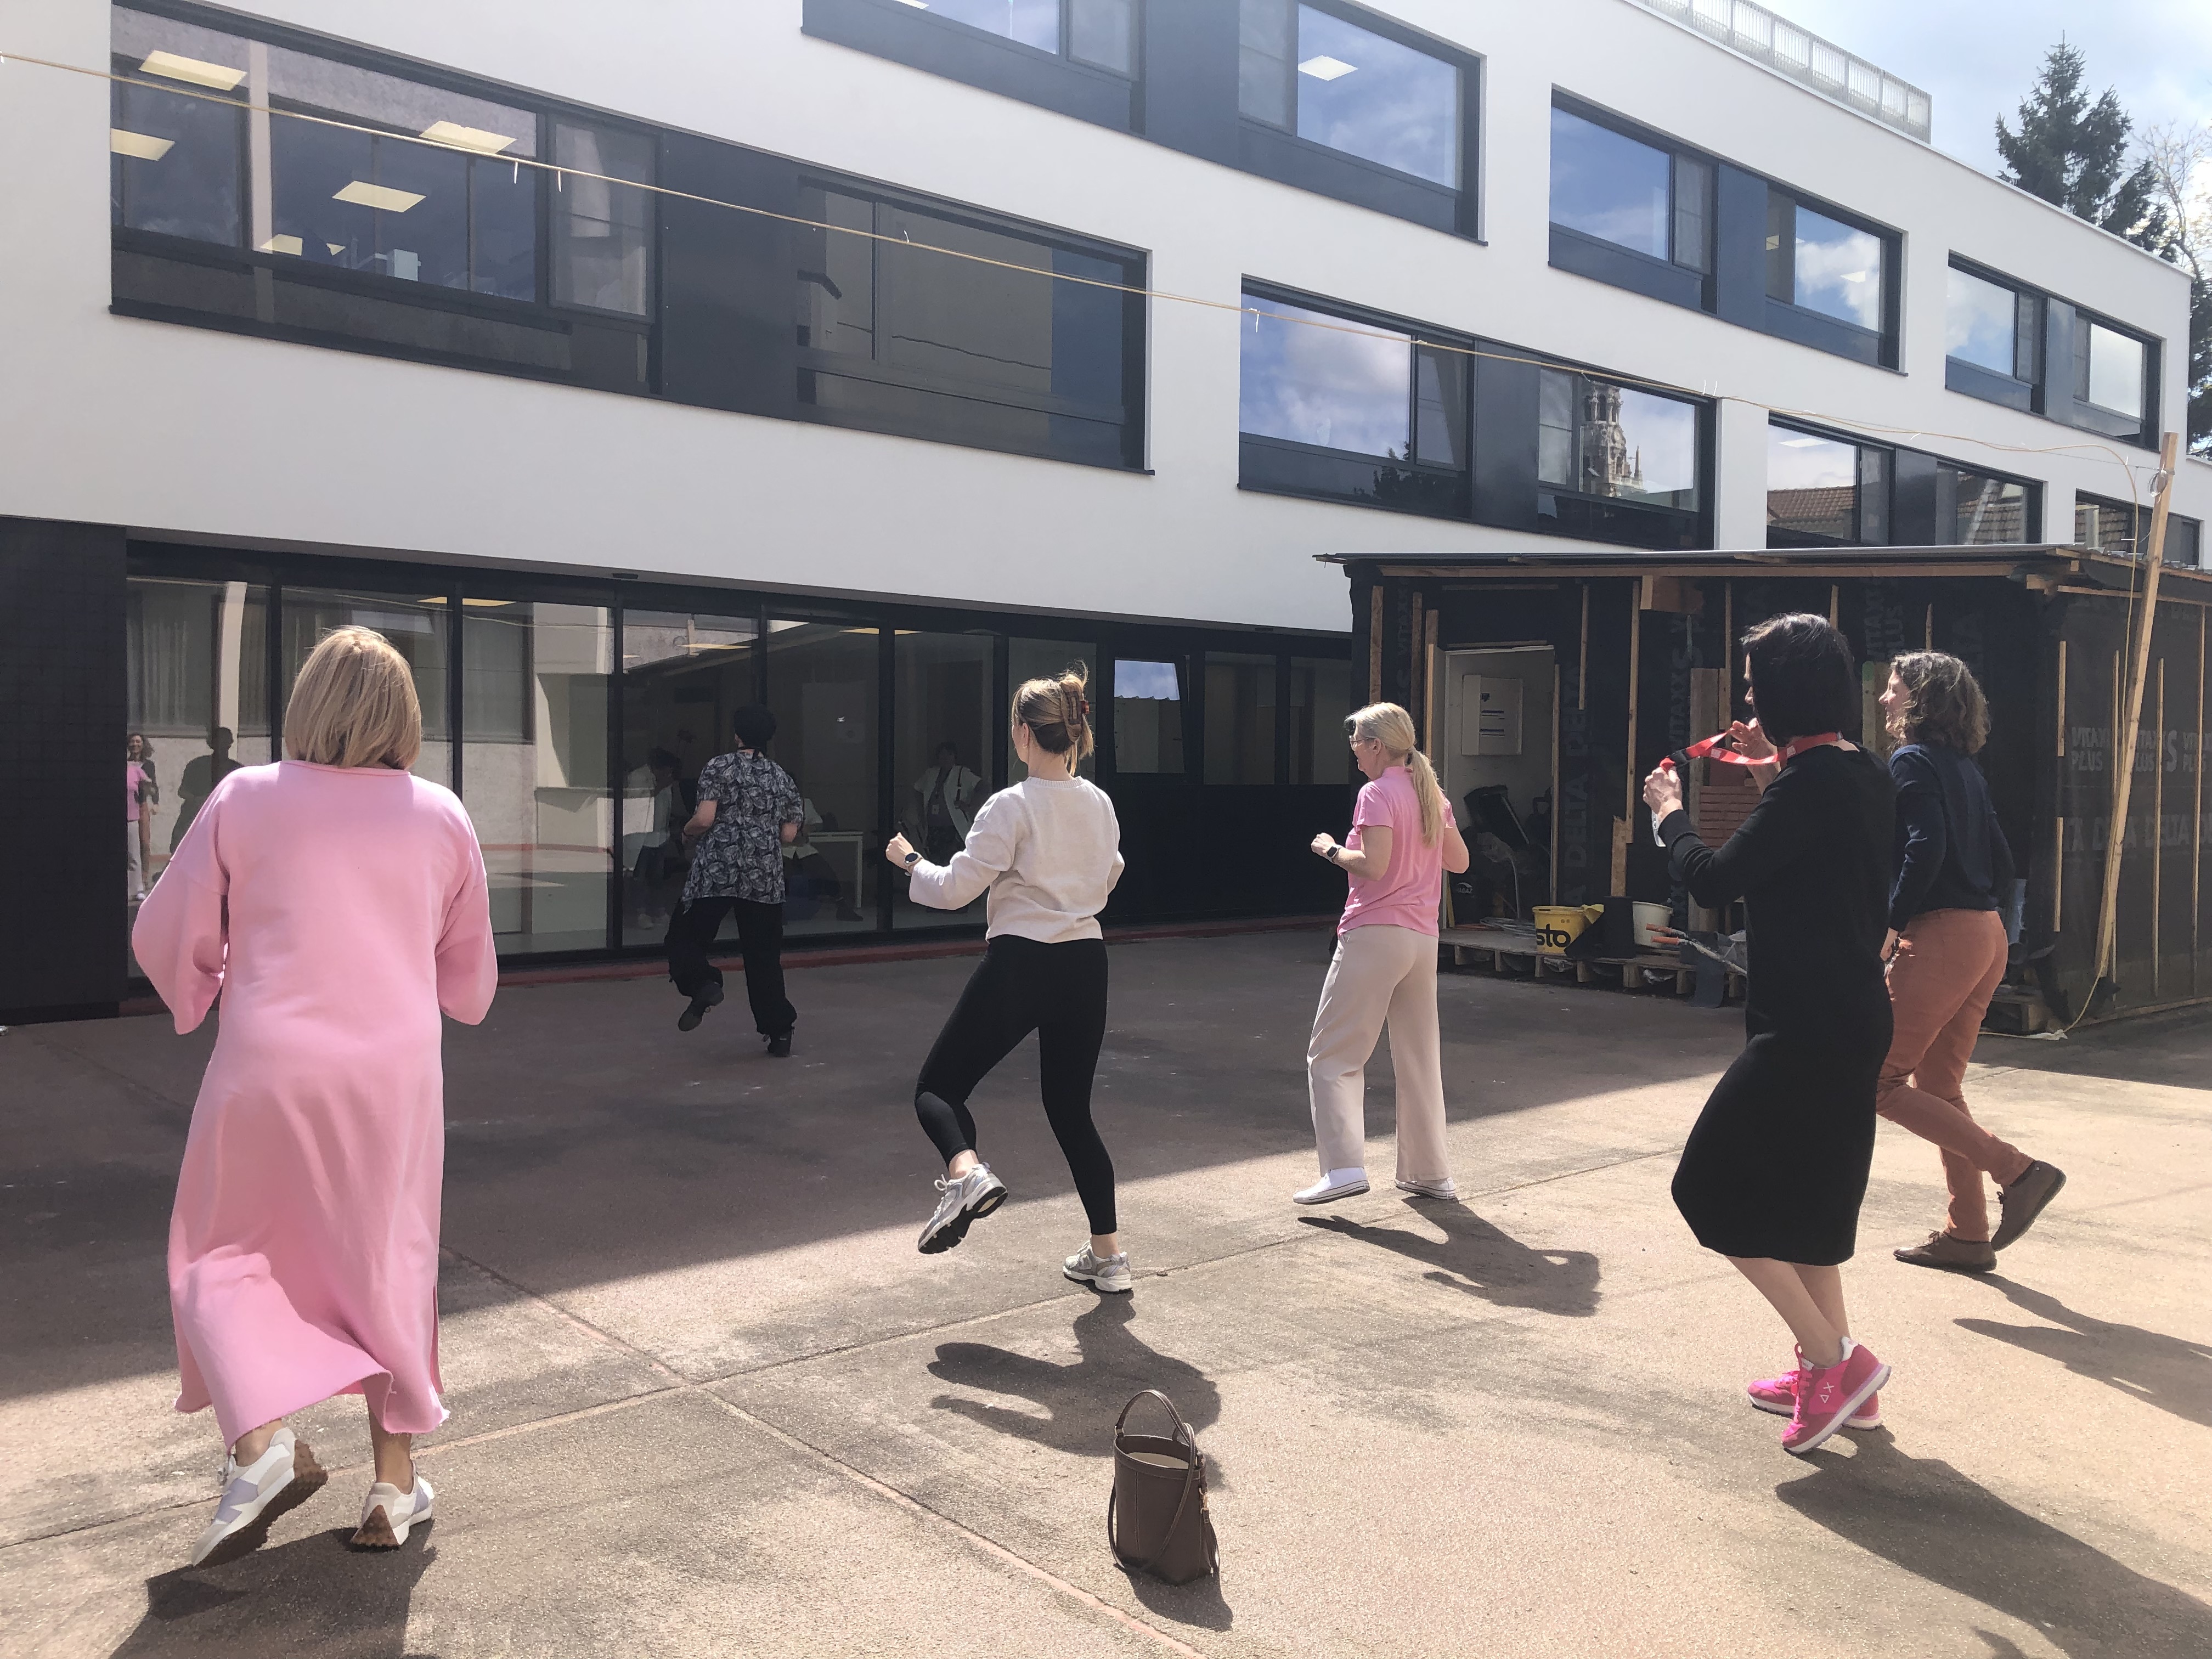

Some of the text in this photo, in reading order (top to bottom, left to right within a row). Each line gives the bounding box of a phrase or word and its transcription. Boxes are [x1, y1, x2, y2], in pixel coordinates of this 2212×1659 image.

[2071, 750, 2103, 771] PLUS
[2135, 752, 2155, 772] LUS
[1564, 773, 1589, 868] DELTA
[1536, 923, 1571, 948] sto
